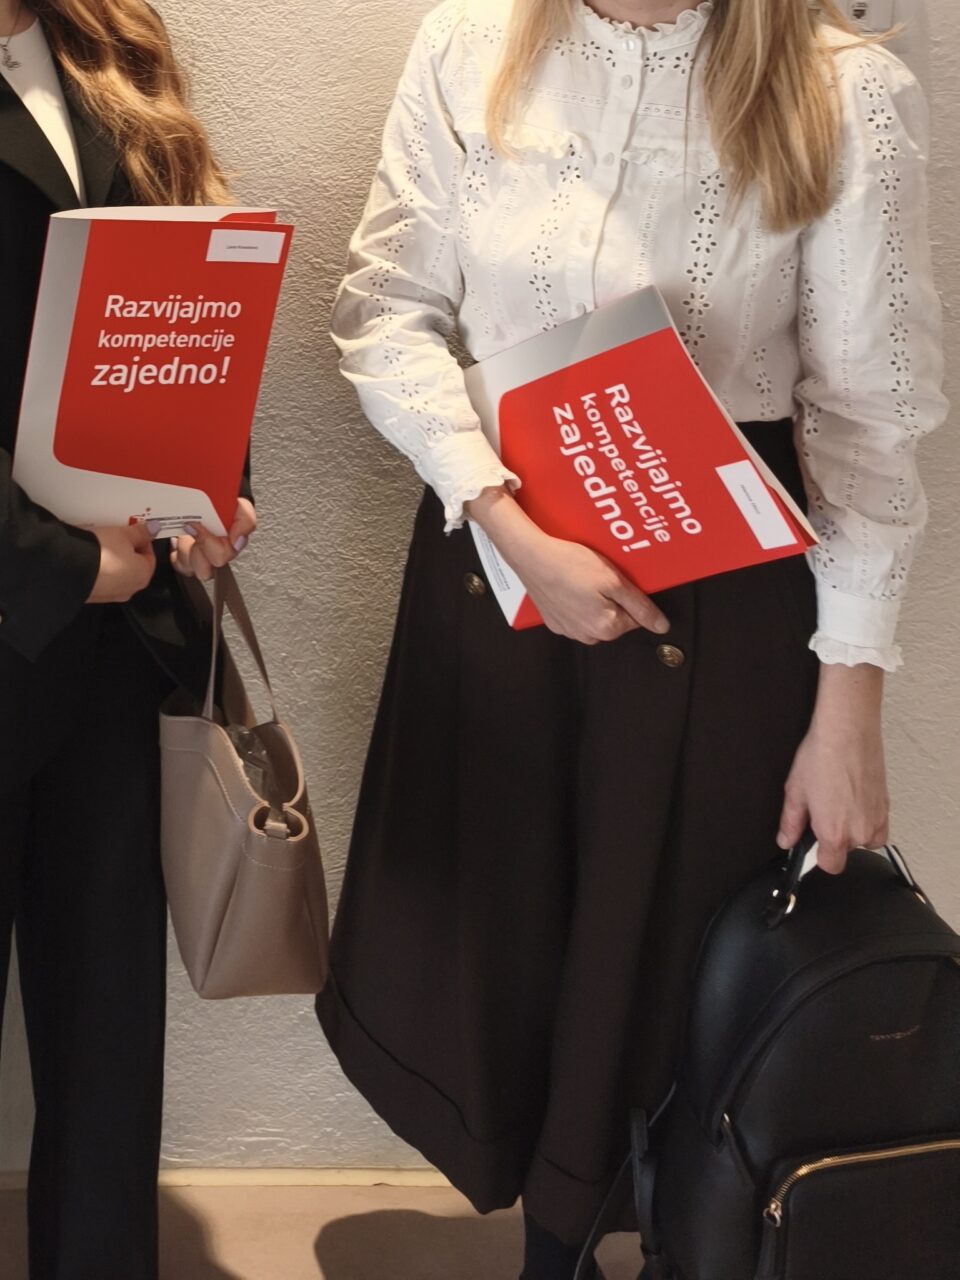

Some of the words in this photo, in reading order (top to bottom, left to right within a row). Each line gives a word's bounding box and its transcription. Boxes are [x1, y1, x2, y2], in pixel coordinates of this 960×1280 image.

[98, 329, 235, 352] kompetencije
[104, 294, 241, 324] Razvijajmo
[90, 355, 230, 392] zajedno!
[552, 402, 651, 553] zajedno!
[580, 392, 671, 544] kompetencije
[604, 383, 702, 536] Razvijajmo
